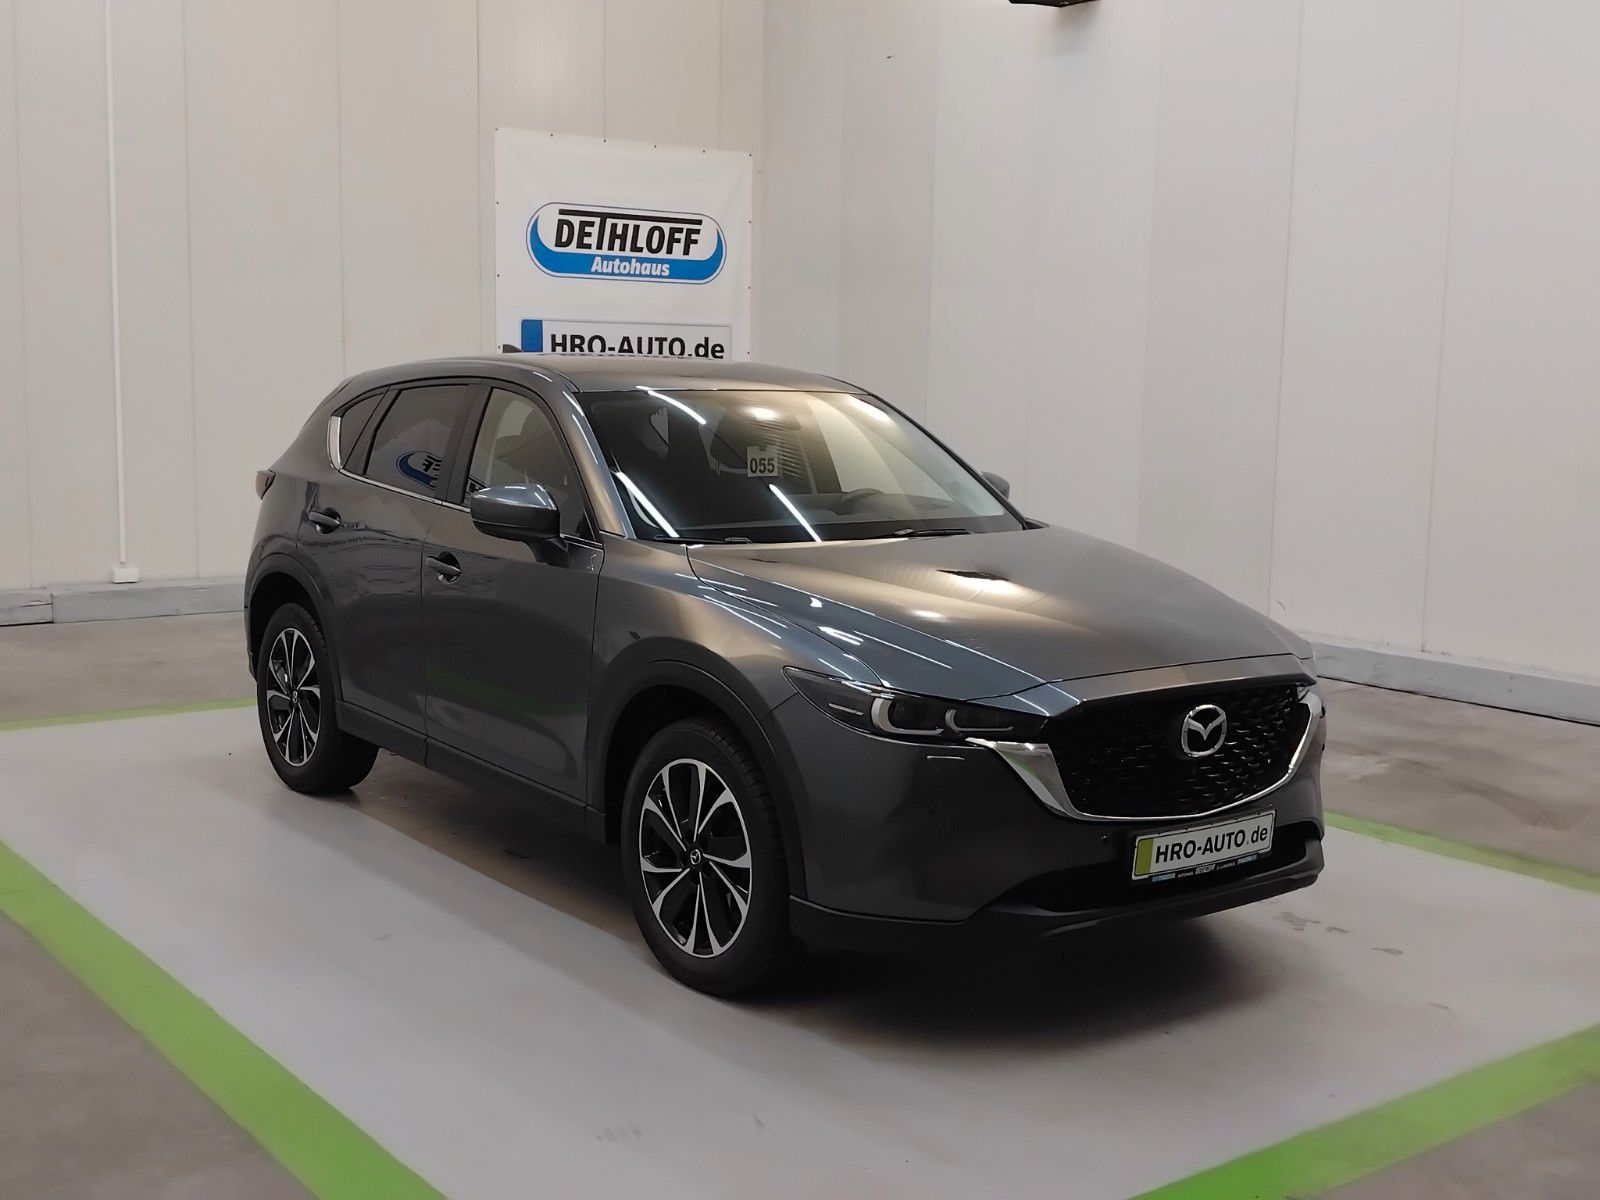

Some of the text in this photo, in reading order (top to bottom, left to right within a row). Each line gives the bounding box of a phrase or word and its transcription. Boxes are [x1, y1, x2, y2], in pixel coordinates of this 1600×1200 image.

[554, 208, 703, 257] DETHLOFF
[590, 256, 671, 277] Autohaus
[550, 333, 726, 360] HRO-AUTO.de
[750, 457, 776, 474] 055
